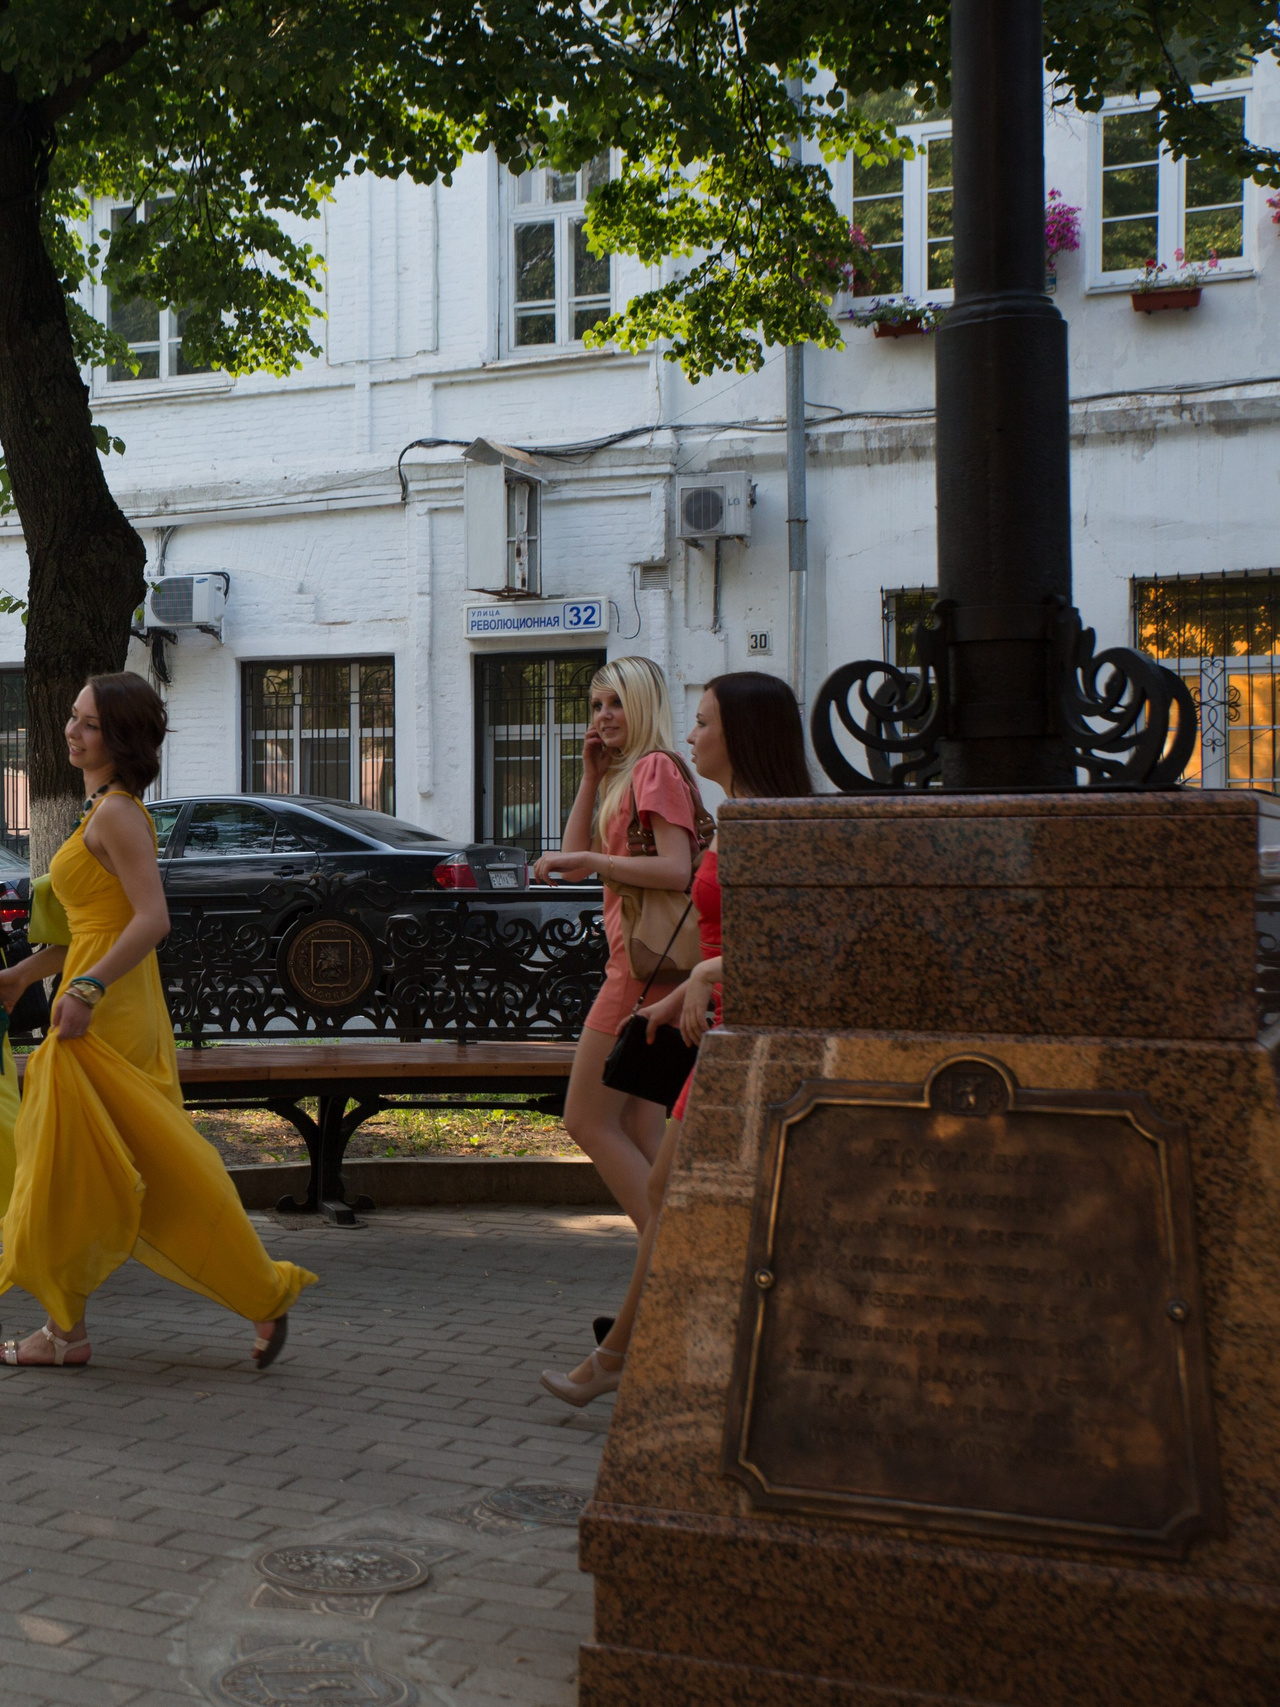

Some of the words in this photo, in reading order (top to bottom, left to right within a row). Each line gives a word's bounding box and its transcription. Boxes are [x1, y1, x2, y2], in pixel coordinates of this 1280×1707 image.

[470, 616, 560, 631] РЕВОЛЮЦИОННАЯ
[568, 605, 597, 626] 32
[471, 609, 501, 618] УЛИЦА
[750, 633, 768, 649] 30
